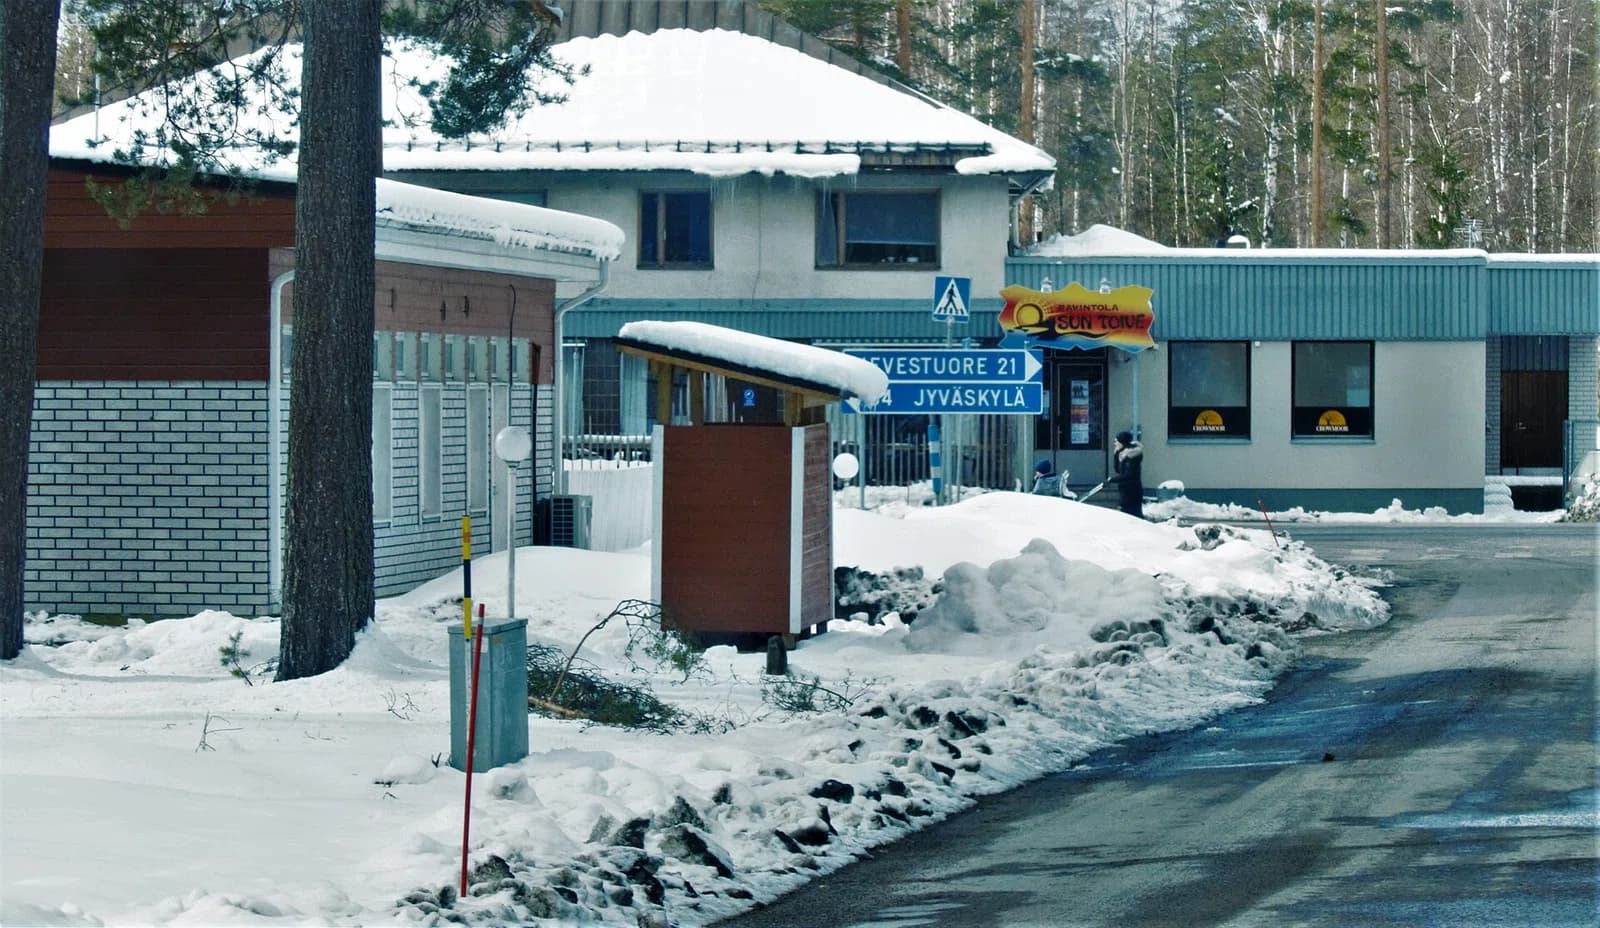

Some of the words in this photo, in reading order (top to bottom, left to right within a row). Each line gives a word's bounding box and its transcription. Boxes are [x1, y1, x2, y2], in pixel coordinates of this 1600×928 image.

[1057, 303, 1119, 312] RAVINTOLA
[1057, 314, 1092, 330] SUN
[1098, 313, 1145, 330] TOIVE
[864, 357, 988, 375] VESTUORE
[997, 357, 1016, 375] 21
[913, 386, 1026, 407] JYVÄSKYLÄ
